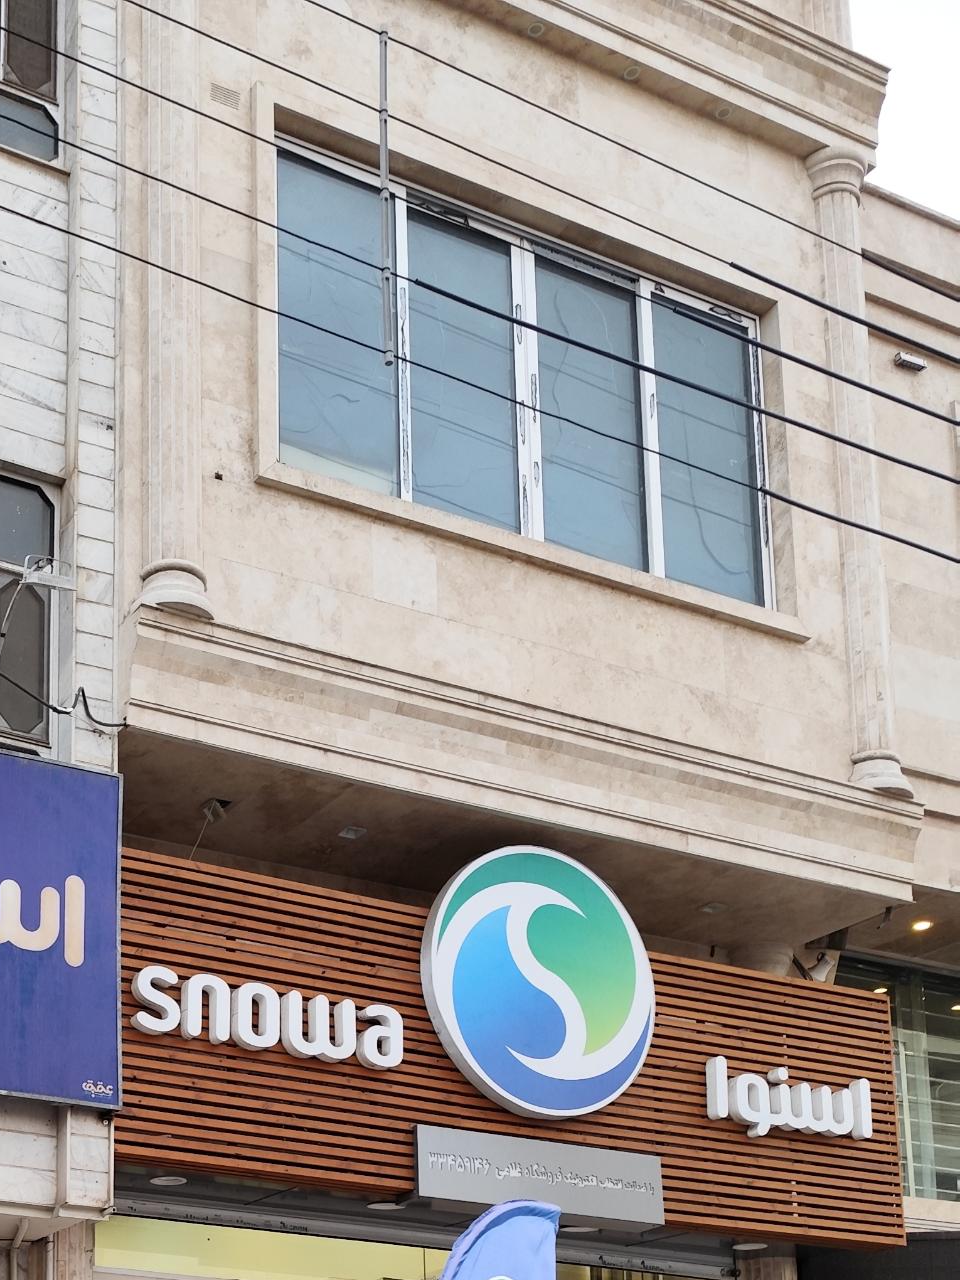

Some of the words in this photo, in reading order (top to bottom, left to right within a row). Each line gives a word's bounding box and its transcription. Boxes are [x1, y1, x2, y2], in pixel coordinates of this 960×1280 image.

[130, 965, 405, 1070] snowa
[705, 1055, 873, 1140] اسنوا
[524, 1165, 563, 1185] فروشگاه
